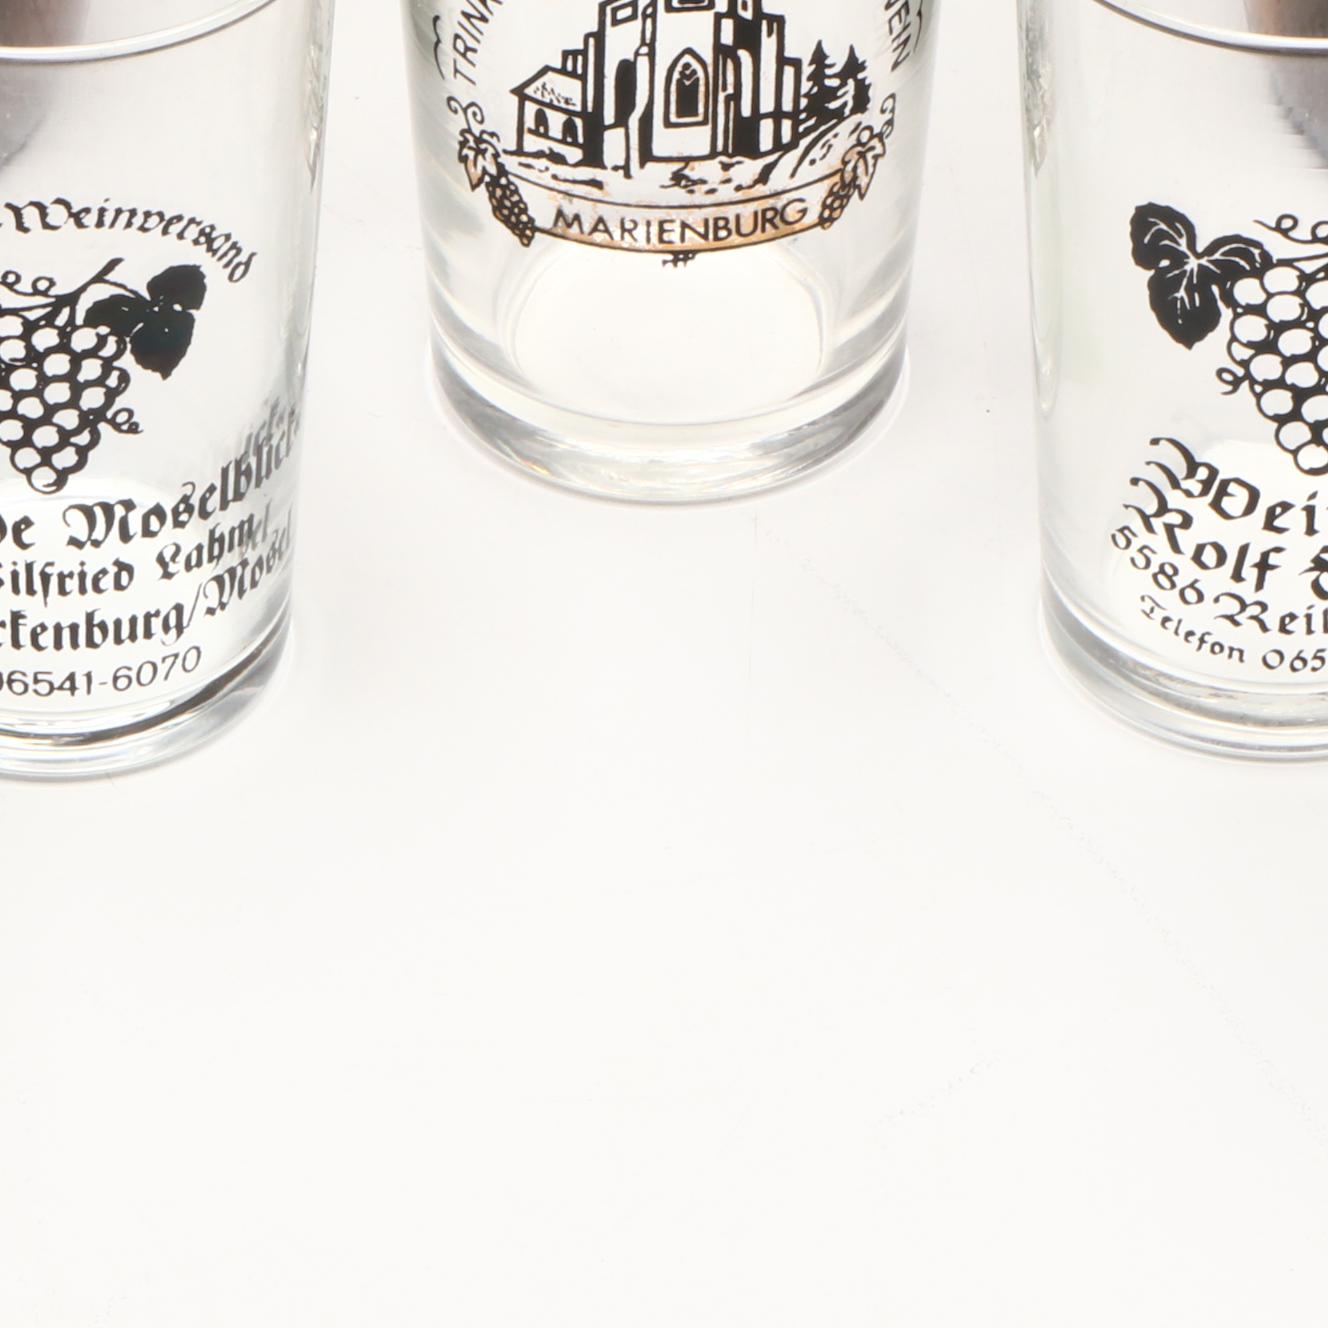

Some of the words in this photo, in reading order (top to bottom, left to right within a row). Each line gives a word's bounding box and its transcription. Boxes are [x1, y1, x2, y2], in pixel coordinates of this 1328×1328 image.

[552, 197, 808, 246] MARIENBURG
[1110, 524, 1205, 606] 5586
[1123, 476, 1286, 593] Rolf
[1140, 594, 1246, 664] Telefon
